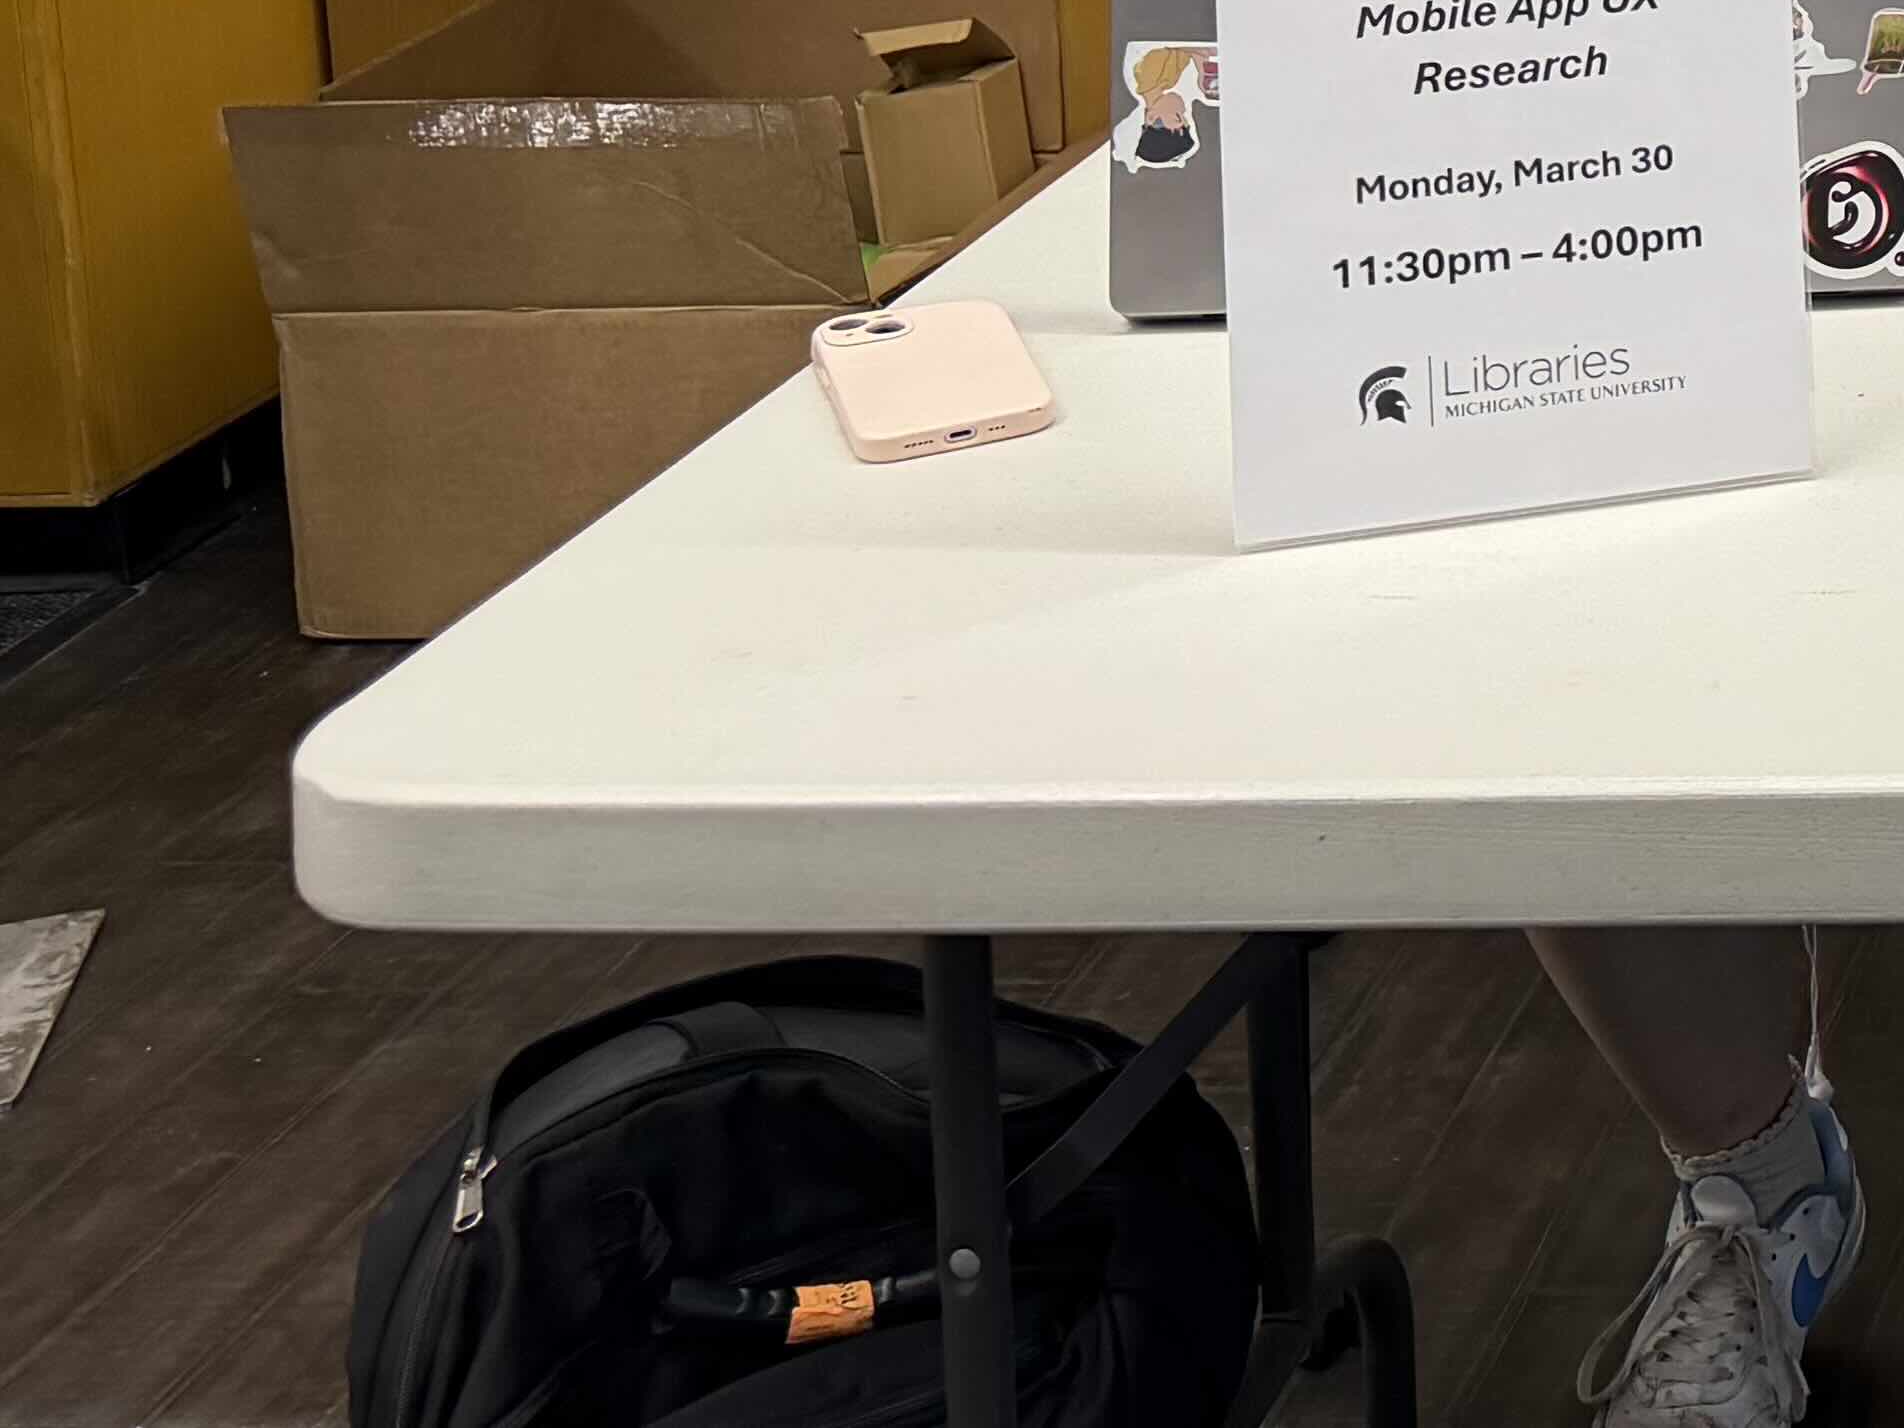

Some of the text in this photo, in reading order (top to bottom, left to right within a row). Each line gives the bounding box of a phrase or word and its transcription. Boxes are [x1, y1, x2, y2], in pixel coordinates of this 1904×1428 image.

[1414, 46, 1607, 94] Research
[1357, 145, 1672, 203] Monday, March 30
[1334, 248, 1510, 288] 11:30pm
[1552, 226, 1701, 262] 4:00pm
[1444, 344, 1634, 399] Libraries
[1445, 372, 1684, 416] MICHIGAN STATE UNIVERSITY
